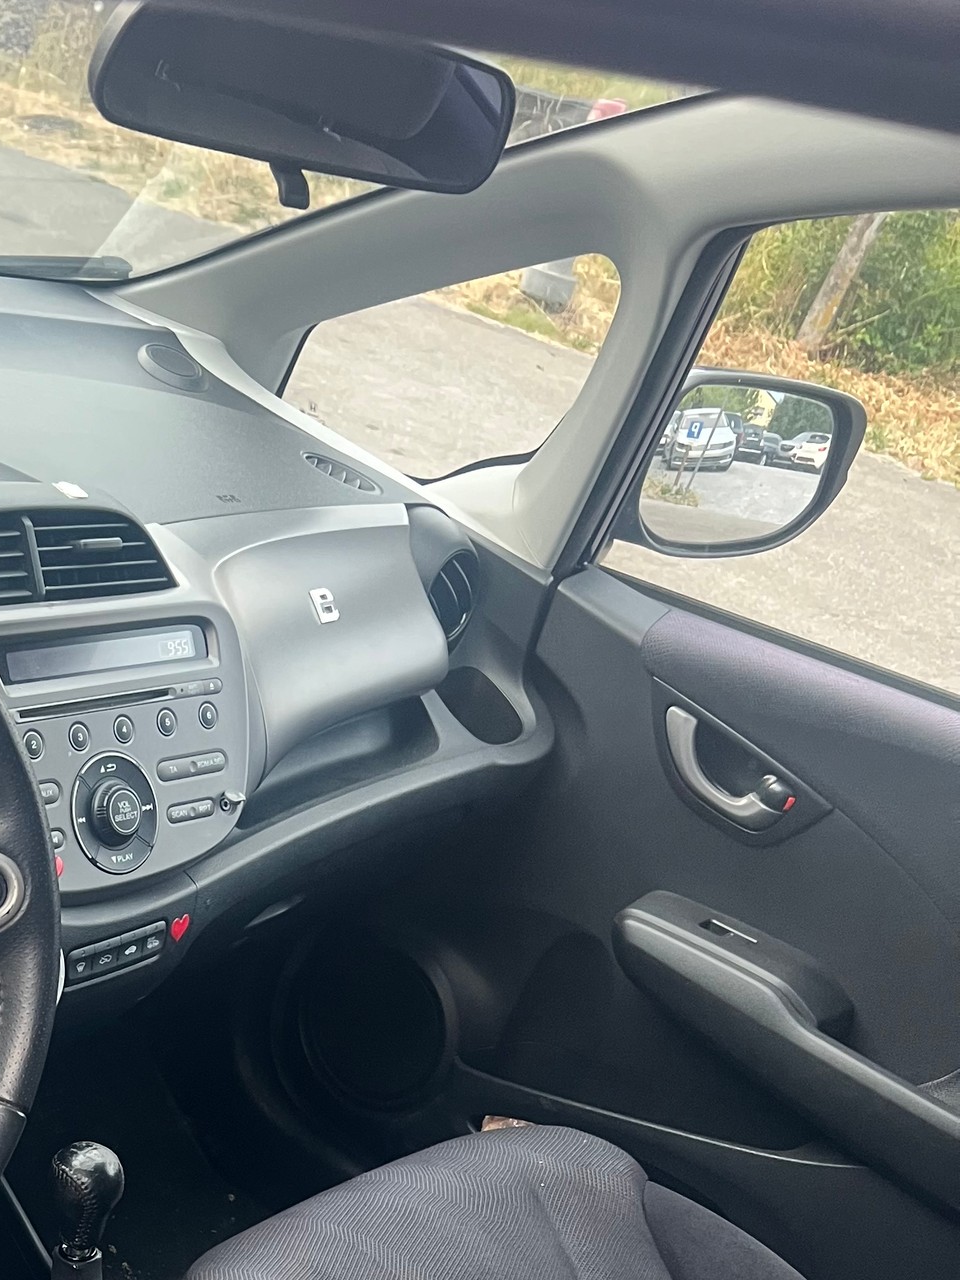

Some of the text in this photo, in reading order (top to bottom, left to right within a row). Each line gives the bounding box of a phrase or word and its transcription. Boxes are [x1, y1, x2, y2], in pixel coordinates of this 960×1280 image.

[205, 709, 213, 720] 6
[163, 715, 172, 726] 5
[120, 722, 129, 735] 4
[76, 730, 85, 742] 3
[30, 739, 38, 750] 2
[169, 765, 178, 774] TA
[171, 809, 188, 819] SCAN
[198, 804, 211, 813] RPT
[114, 810, 138, 822] SELECT
[117, 853, 134, 863] PLAY
